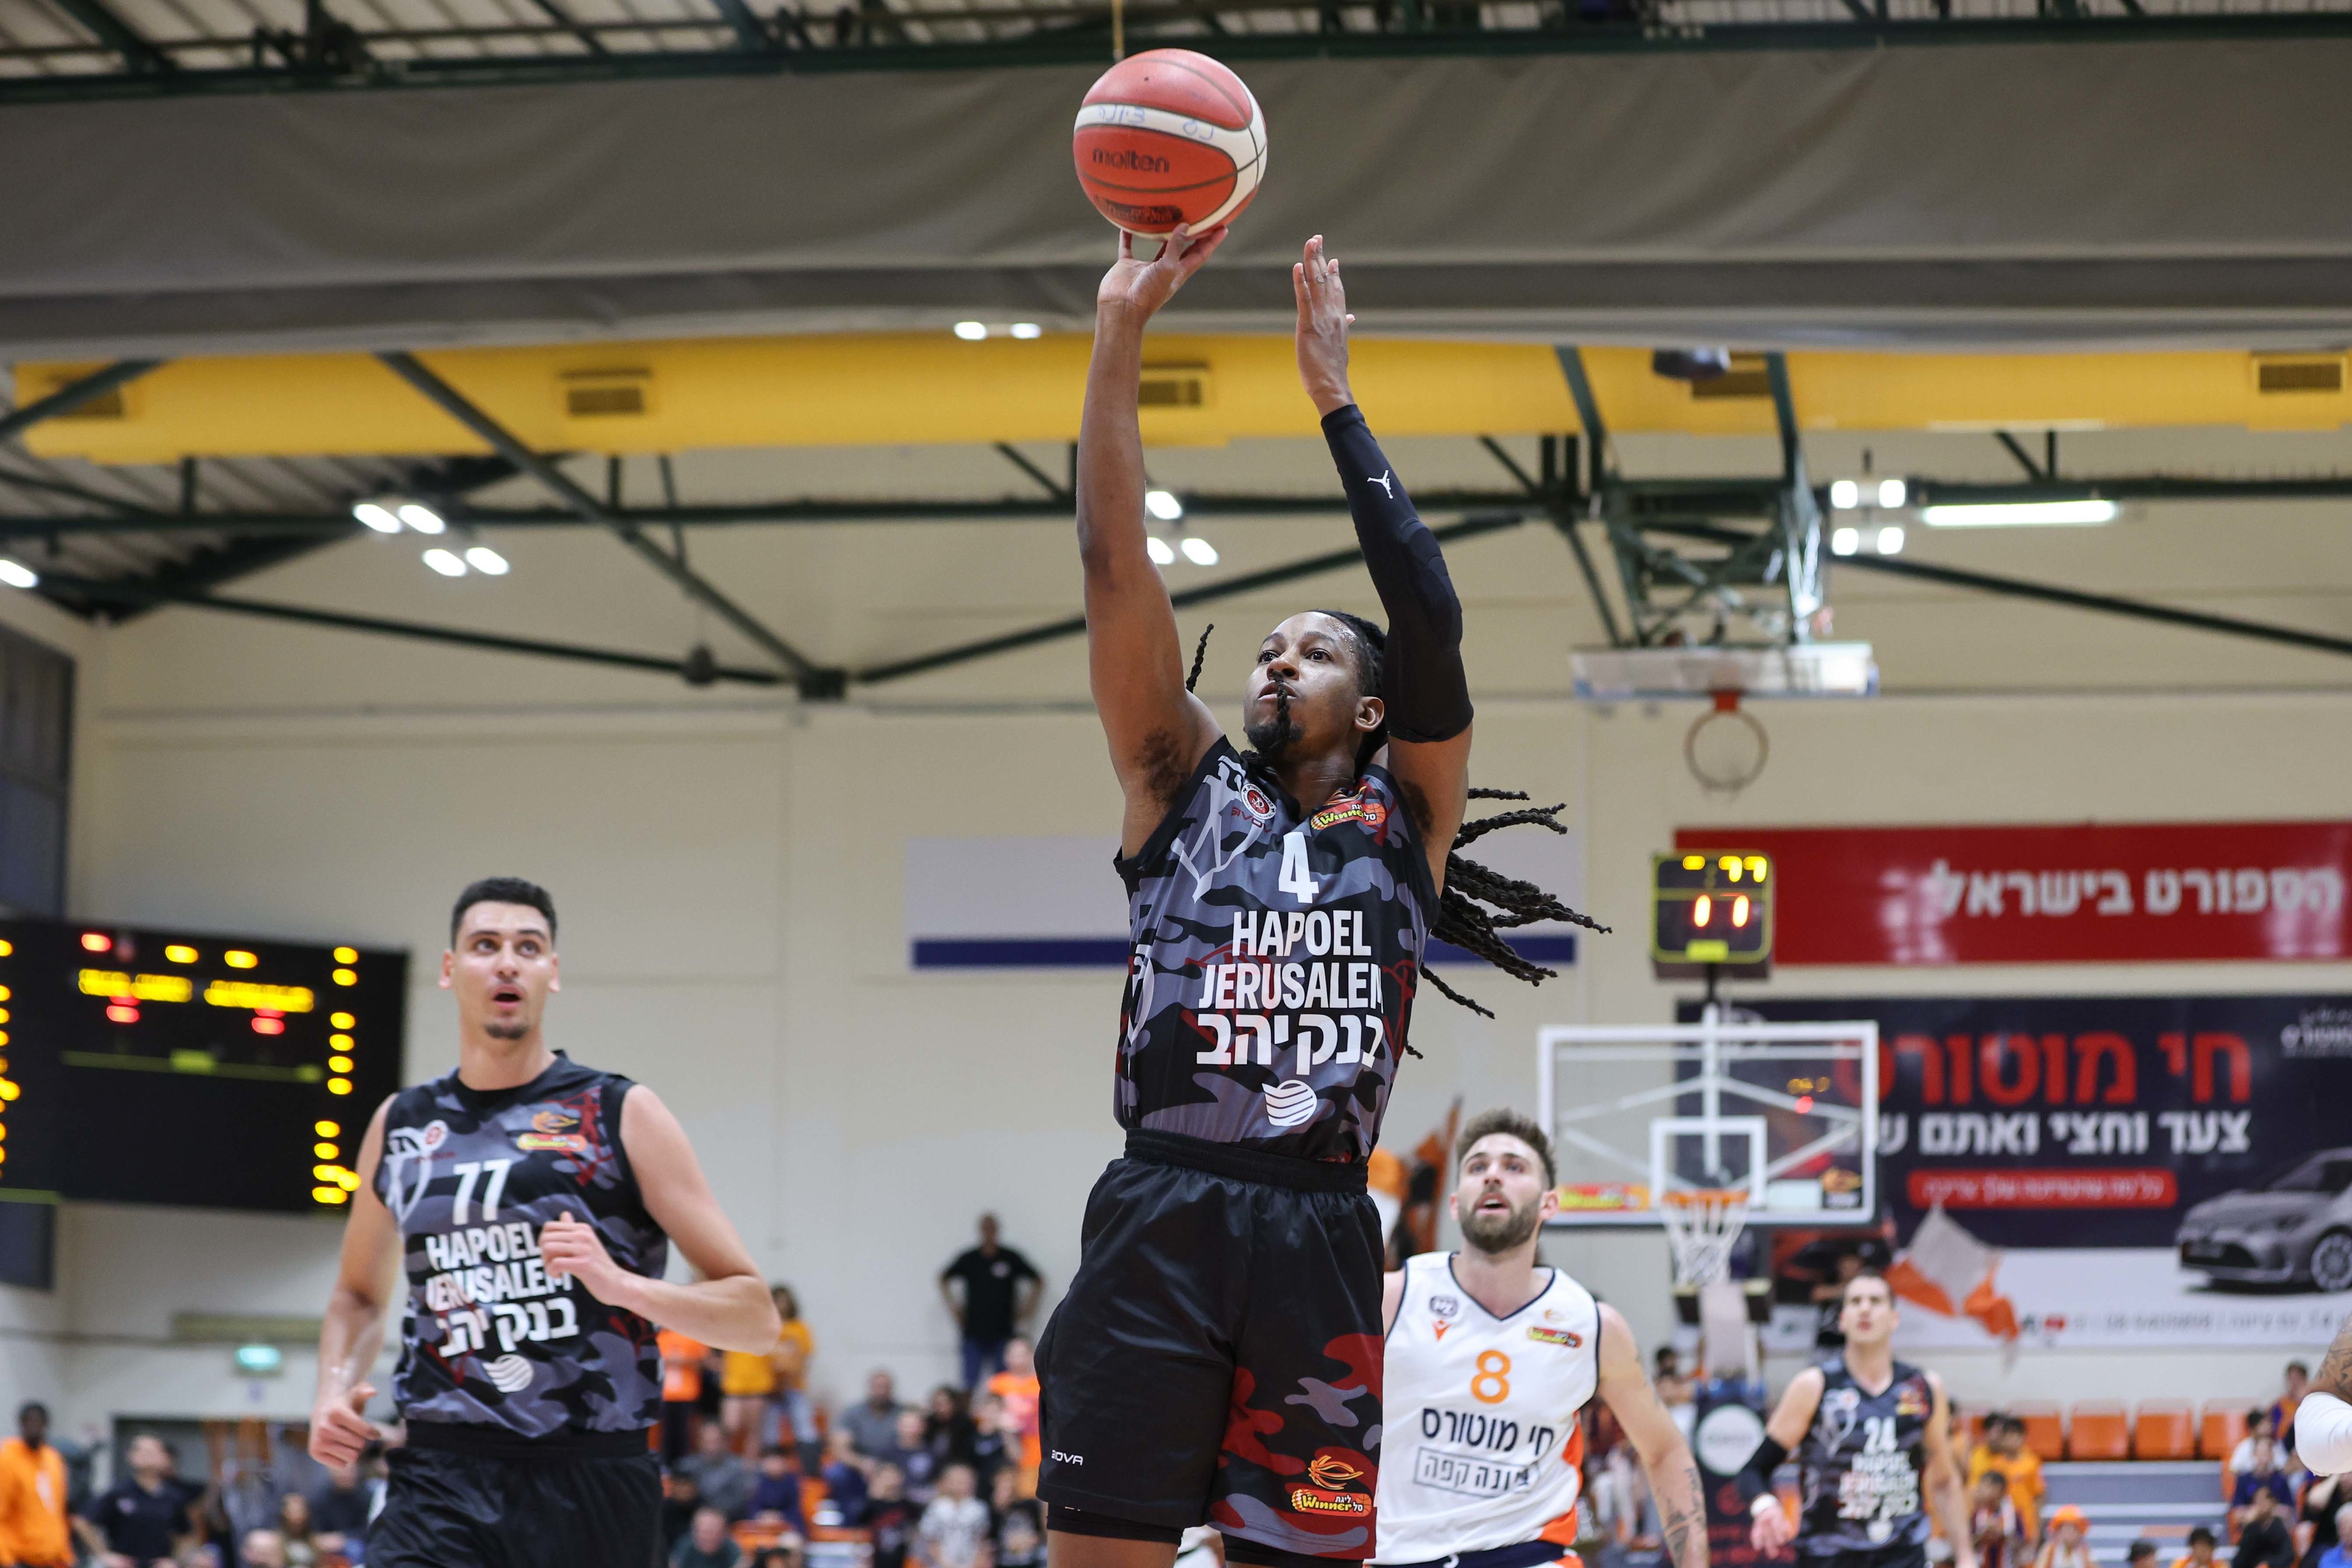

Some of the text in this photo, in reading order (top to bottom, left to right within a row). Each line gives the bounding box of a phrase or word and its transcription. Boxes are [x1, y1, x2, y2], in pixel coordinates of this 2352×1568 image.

[1093, 148, 1170, 173] molten
[1278, 831, 1319, 903] 4
[1932, 860, 2343, 917] הספורט בישראל
[1232, 910, 1372, 956] HAPOEL
[2157, 1032, 2251, 1104] חי
[1919, 1111, 2041, 1156] ואתם
[2047, 1111, 2150, 1155] וחצי
[2157, 1111, 2251, 1154] צעד
[452, 1158, 513, 1225] 77
[425, 1222, 543, 1272] HAPOEL
[1471, 1350, 1511, 1404] 8
[1422, 1407, 1554, 1456] חי מוטורס
[1425, 1456, 1470, 1489] קפה
[1302, 1495, 1363, 1512] Winner סל
[1335, 1495, 1352, 1503] ליגת
